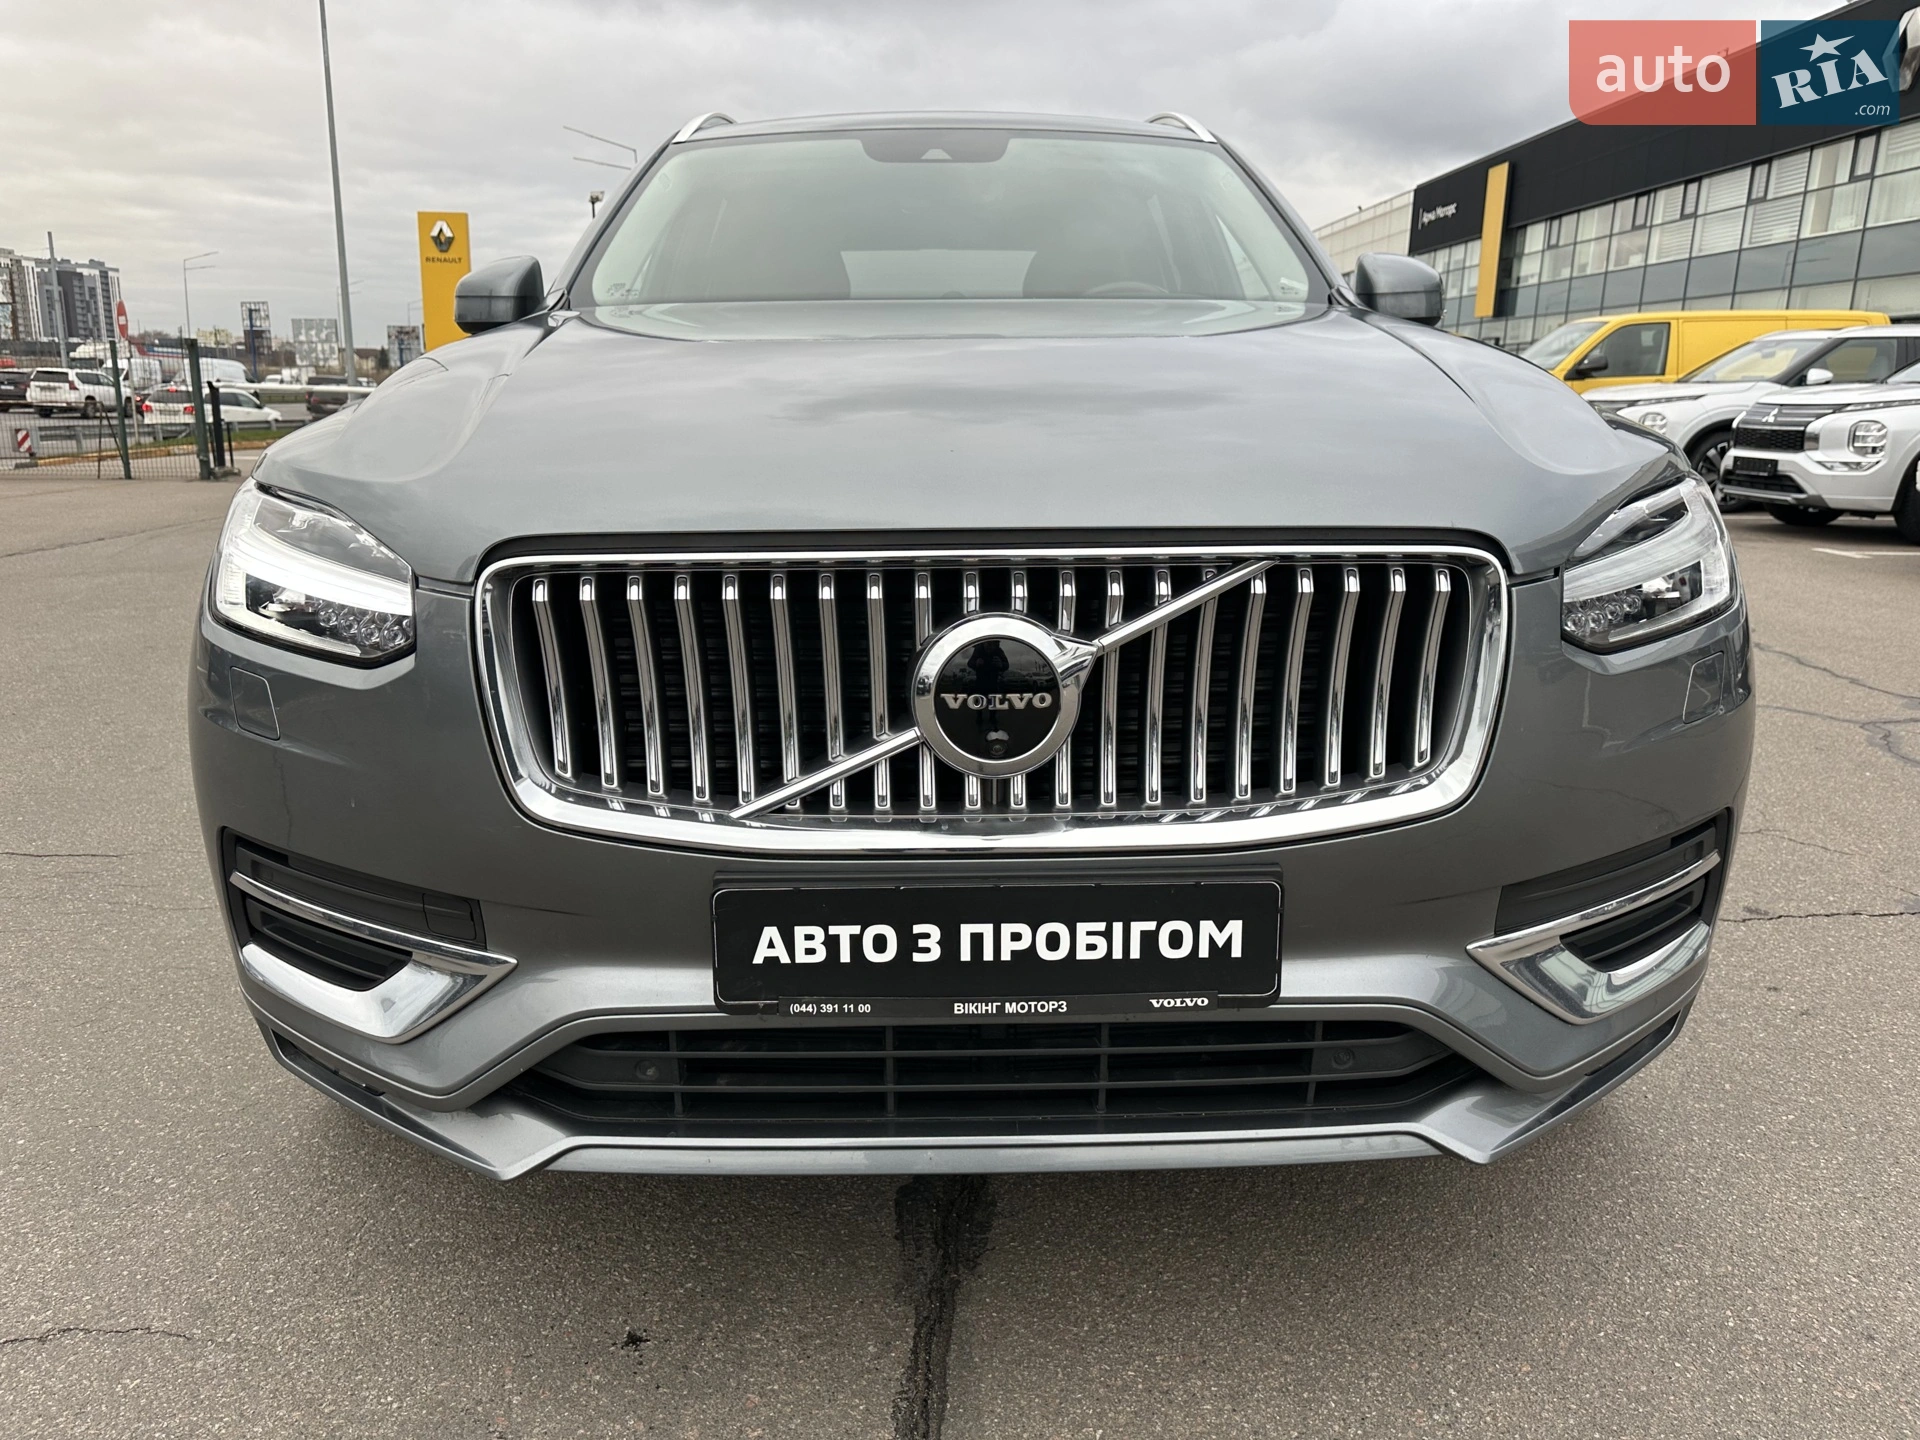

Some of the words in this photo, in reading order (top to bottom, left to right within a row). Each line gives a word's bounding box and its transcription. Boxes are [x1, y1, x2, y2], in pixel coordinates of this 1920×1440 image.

[425, 256, 462, 264] RENAULT
[940, 692, 1053, 711] VOLVO
[752, 924, 898, 965] АВТО
[960, 919, 1243, 962] ПРОБІГОМ
[789, 1003, 817, 1014] (044)
[819, 1003, 839, 1013] 391
[842, 1003, 855, 1013] 11
[857, 1003, 871, 1013] 00
[953, 1002, 1001, 1014] ВІКІНГ
[1004, 1000, 1068, 1014] МОТОРЗ
[1149, 997, 1209, 1008] VOLVO
